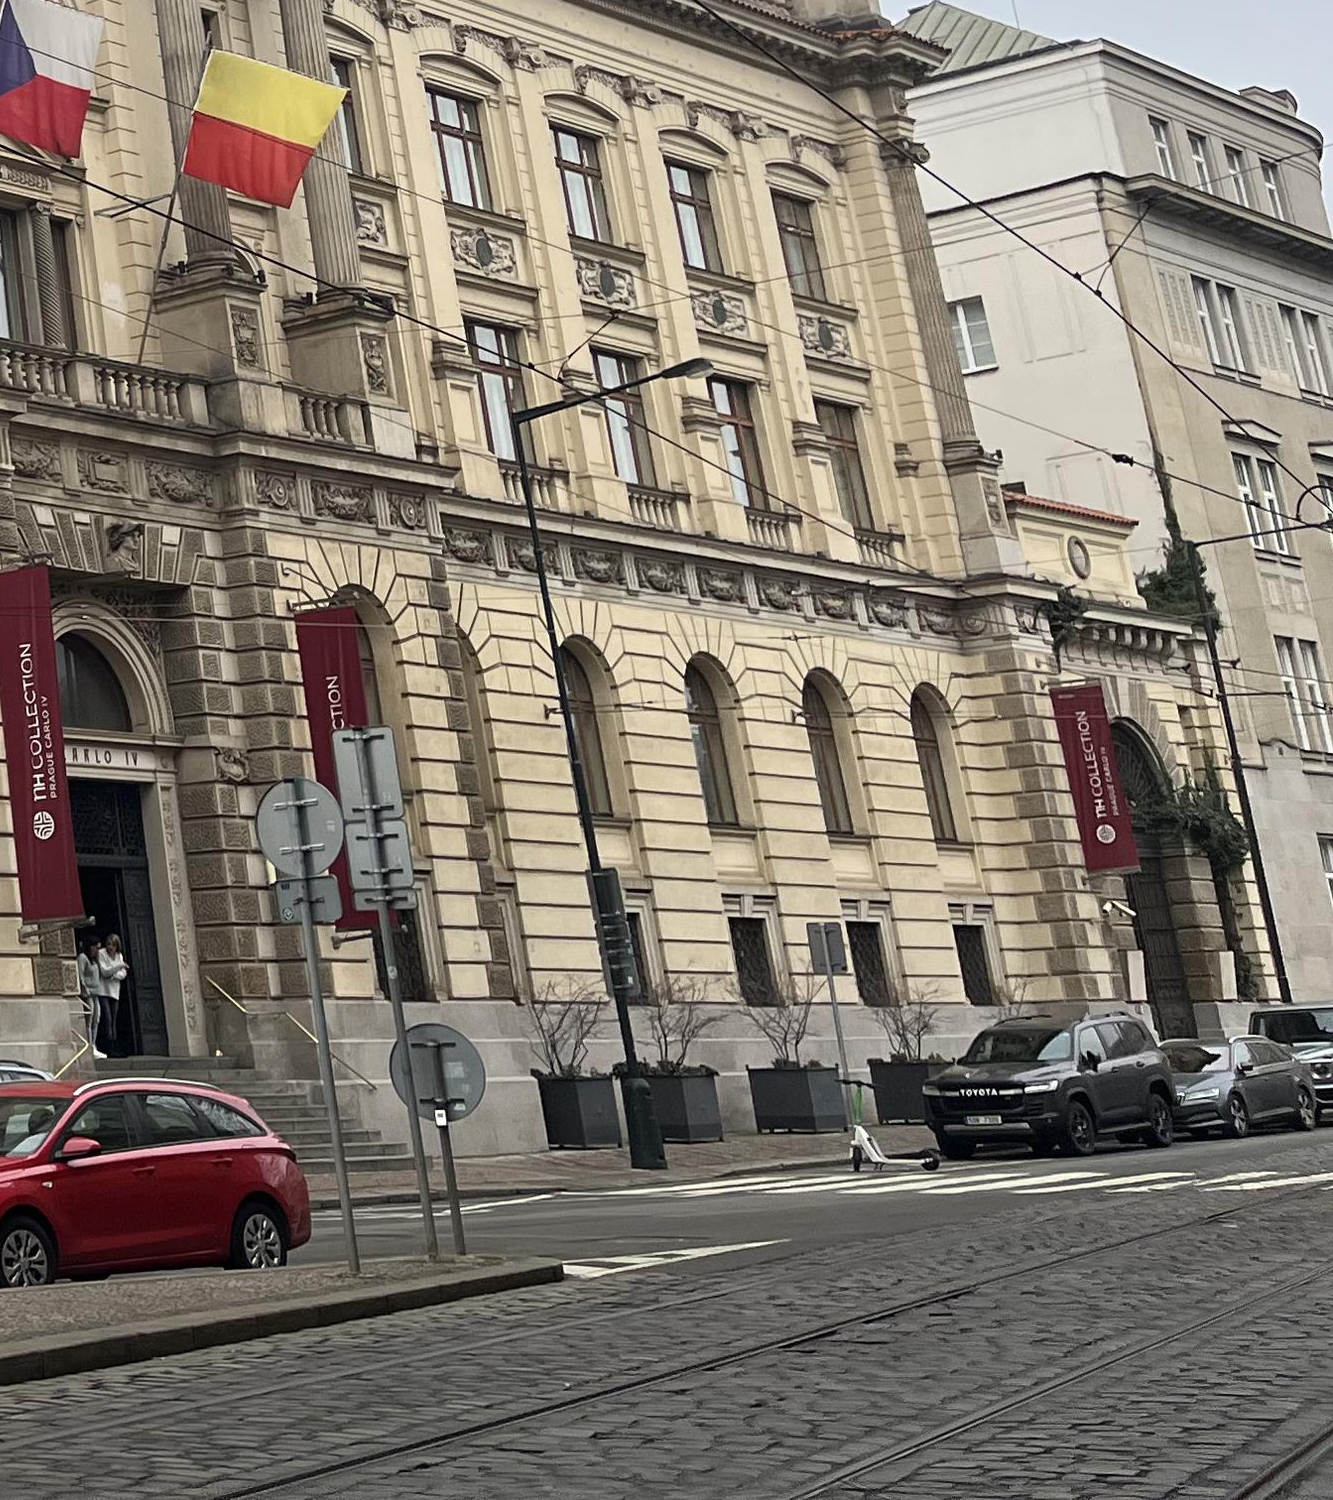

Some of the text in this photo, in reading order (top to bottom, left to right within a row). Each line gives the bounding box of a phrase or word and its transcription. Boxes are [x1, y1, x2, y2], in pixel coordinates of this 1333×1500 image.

[19, 643, 44, 770] COLLECTION
[325, 675, 345, 729] CTION
[40, 696, 58, 799] PRAGUE CARLO IV
[64, 747, 139, 766] ARLO IV
[1075, 710, 1103, 797] COLLECTION
[960, 1088, 998, 1097] TOYOTA
